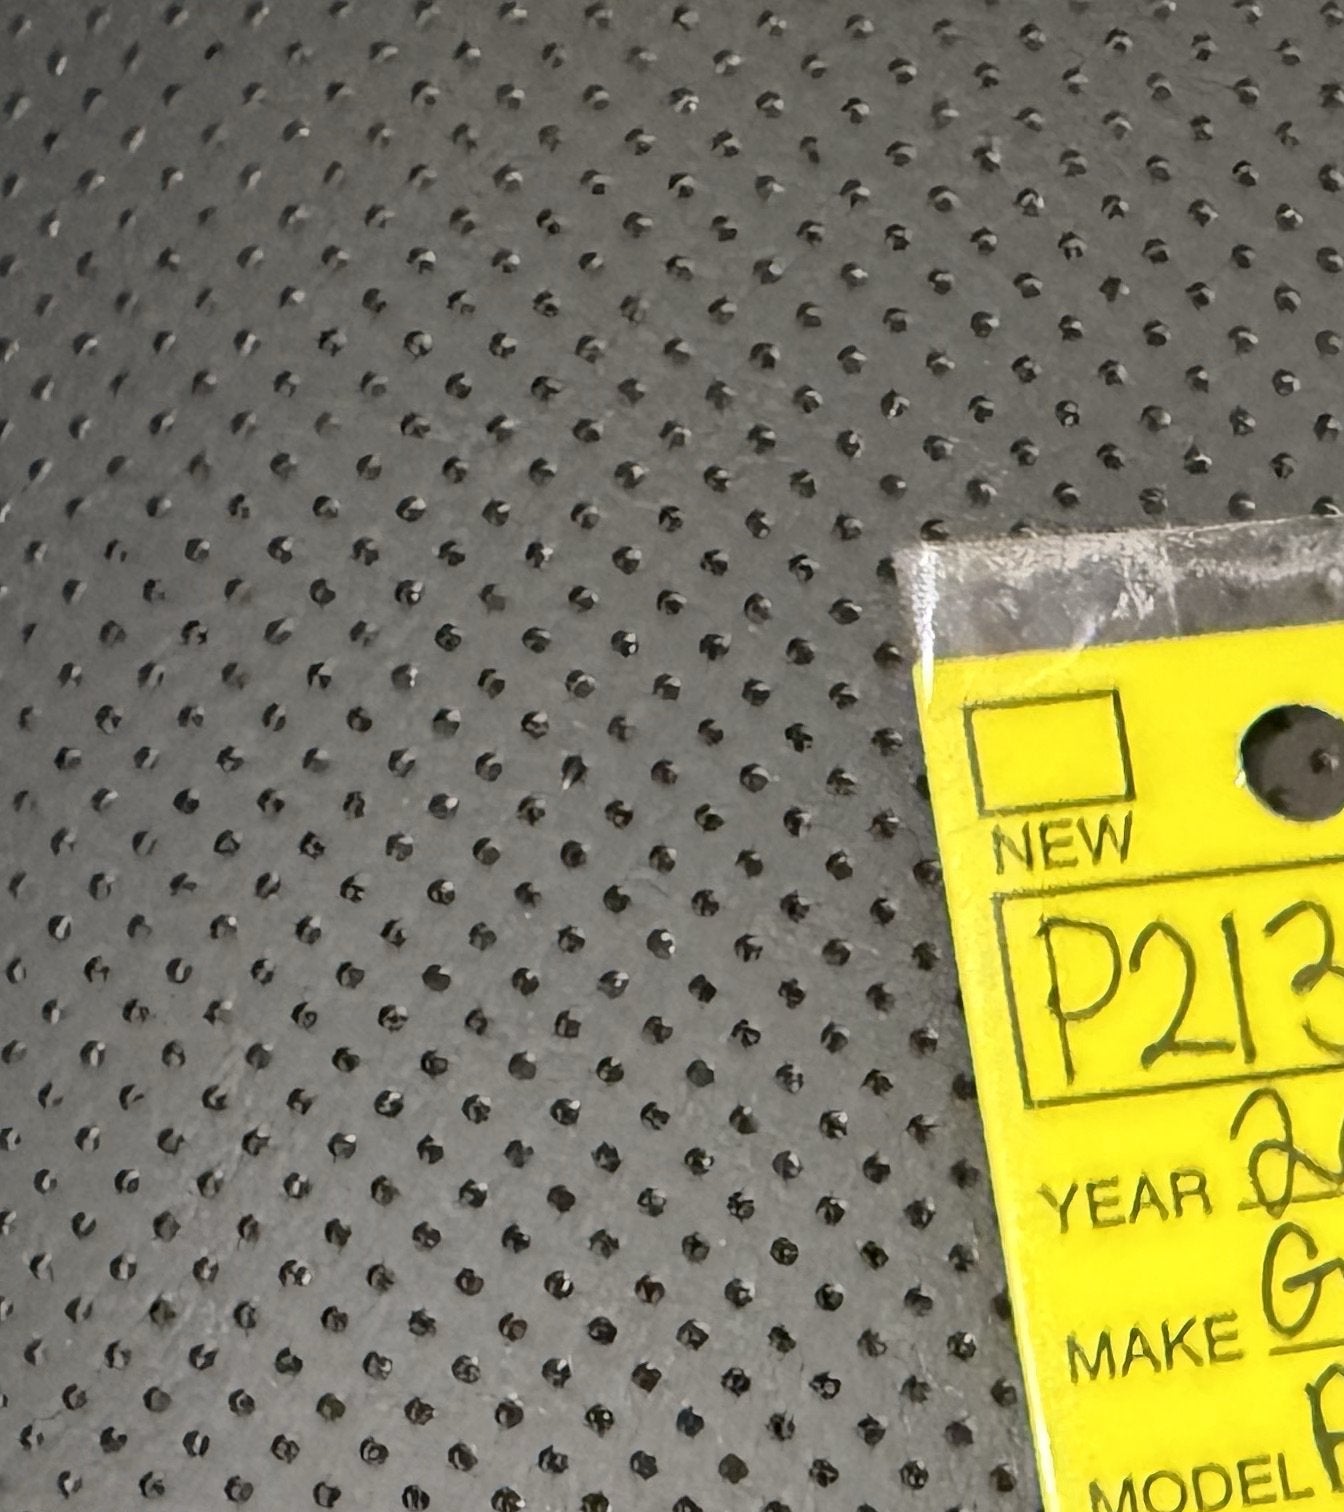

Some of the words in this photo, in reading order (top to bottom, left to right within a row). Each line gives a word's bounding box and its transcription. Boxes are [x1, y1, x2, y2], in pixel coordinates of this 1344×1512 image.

[992, 812, 1134, 874] NEW
[1038, 1169, 1213, 1235] YEAR
[1066, 1310, 1245, 1384] MAKE
